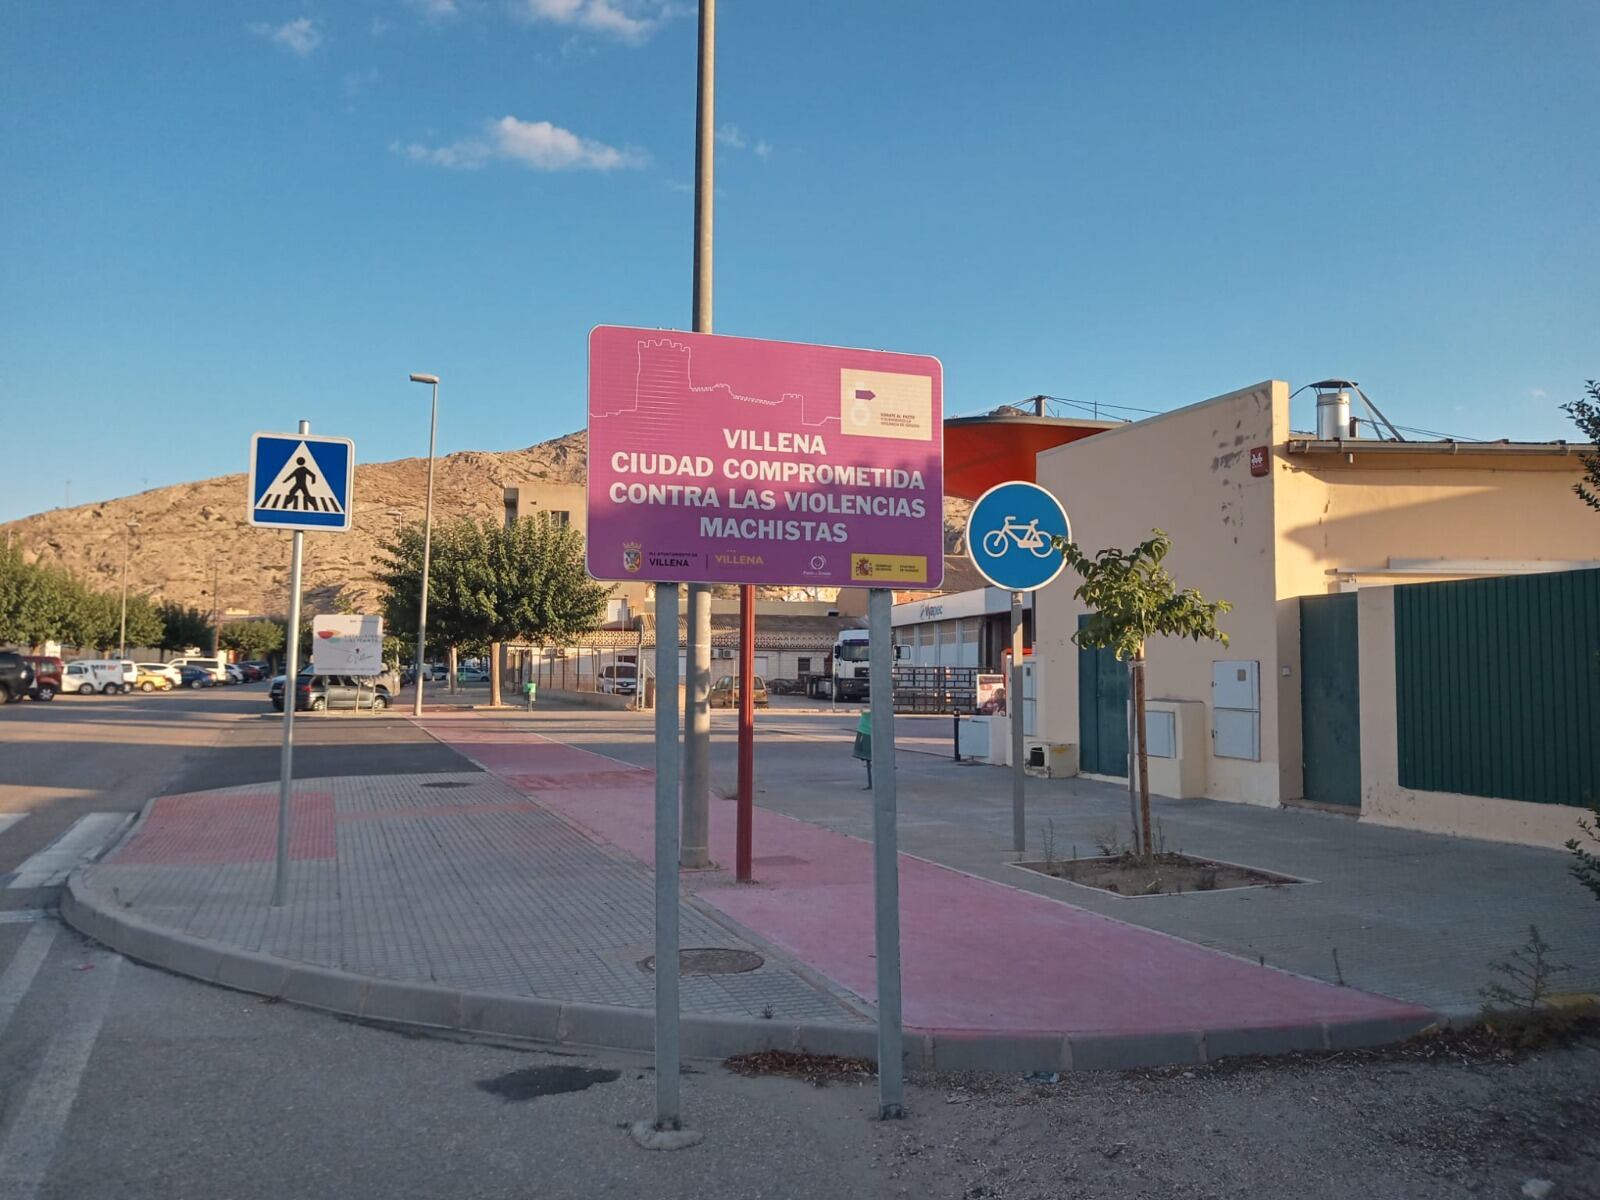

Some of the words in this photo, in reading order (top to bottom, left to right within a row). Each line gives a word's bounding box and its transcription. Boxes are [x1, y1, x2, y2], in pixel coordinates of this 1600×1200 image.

[723, 428, 826, 456] VILLENA
[611, 452, 714, 476] CIUDAD
[723, 459, 925, 490] COMPROMETIDA
[609, 482, 720, 507] CONTRA
[728, 489, 776, 511] LAS
[784, 492, 926, 519] VIOLENCIAS
[700, 517, 848, 543] MACHISTAS
[649, 558, 689, 567] VILLENA
[715, 555, 764, 564] VILLENA
